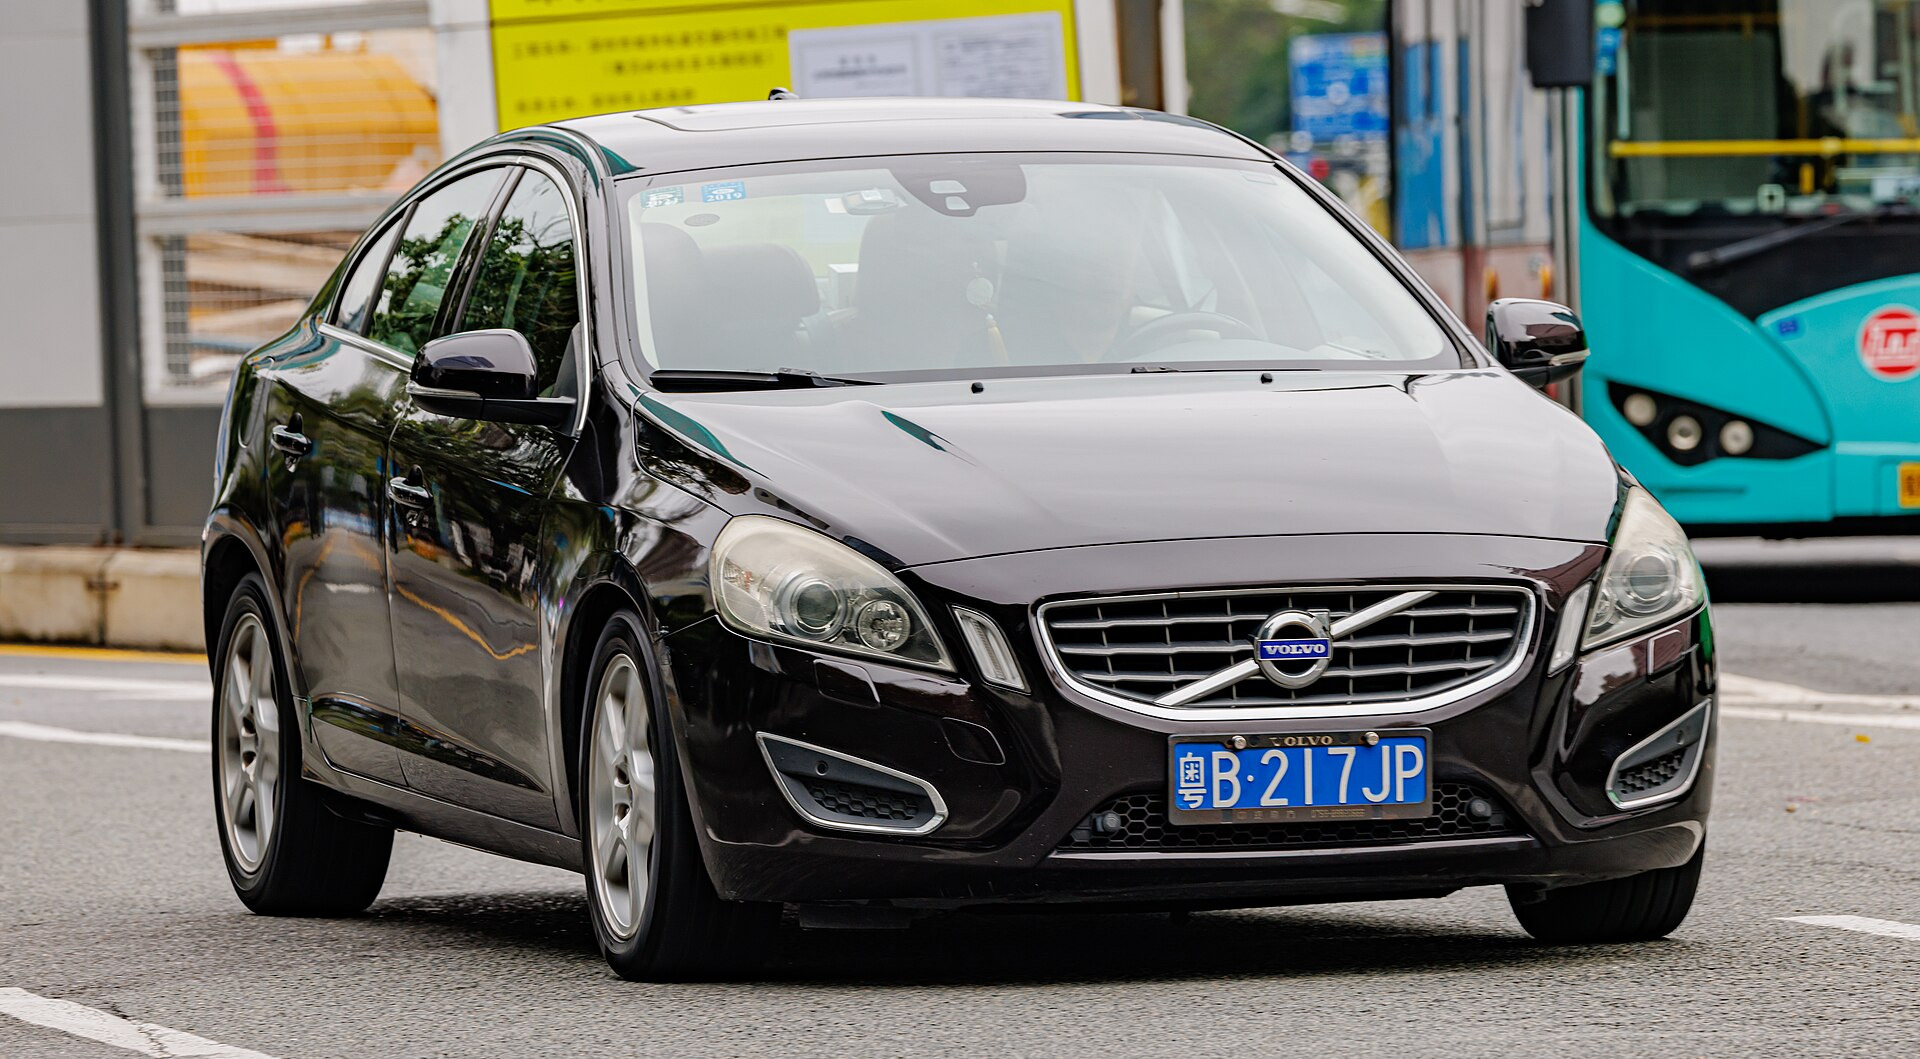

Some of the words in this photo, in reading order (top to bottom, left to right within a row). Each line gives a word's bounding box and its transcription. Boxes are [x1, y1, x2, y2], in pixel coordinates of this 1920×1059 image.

[706, 192, 742, 202] 2019
[1262, 643, 1326, 655] VOLVO
[1177, 744, 1424, 809] 粤B·217JP
